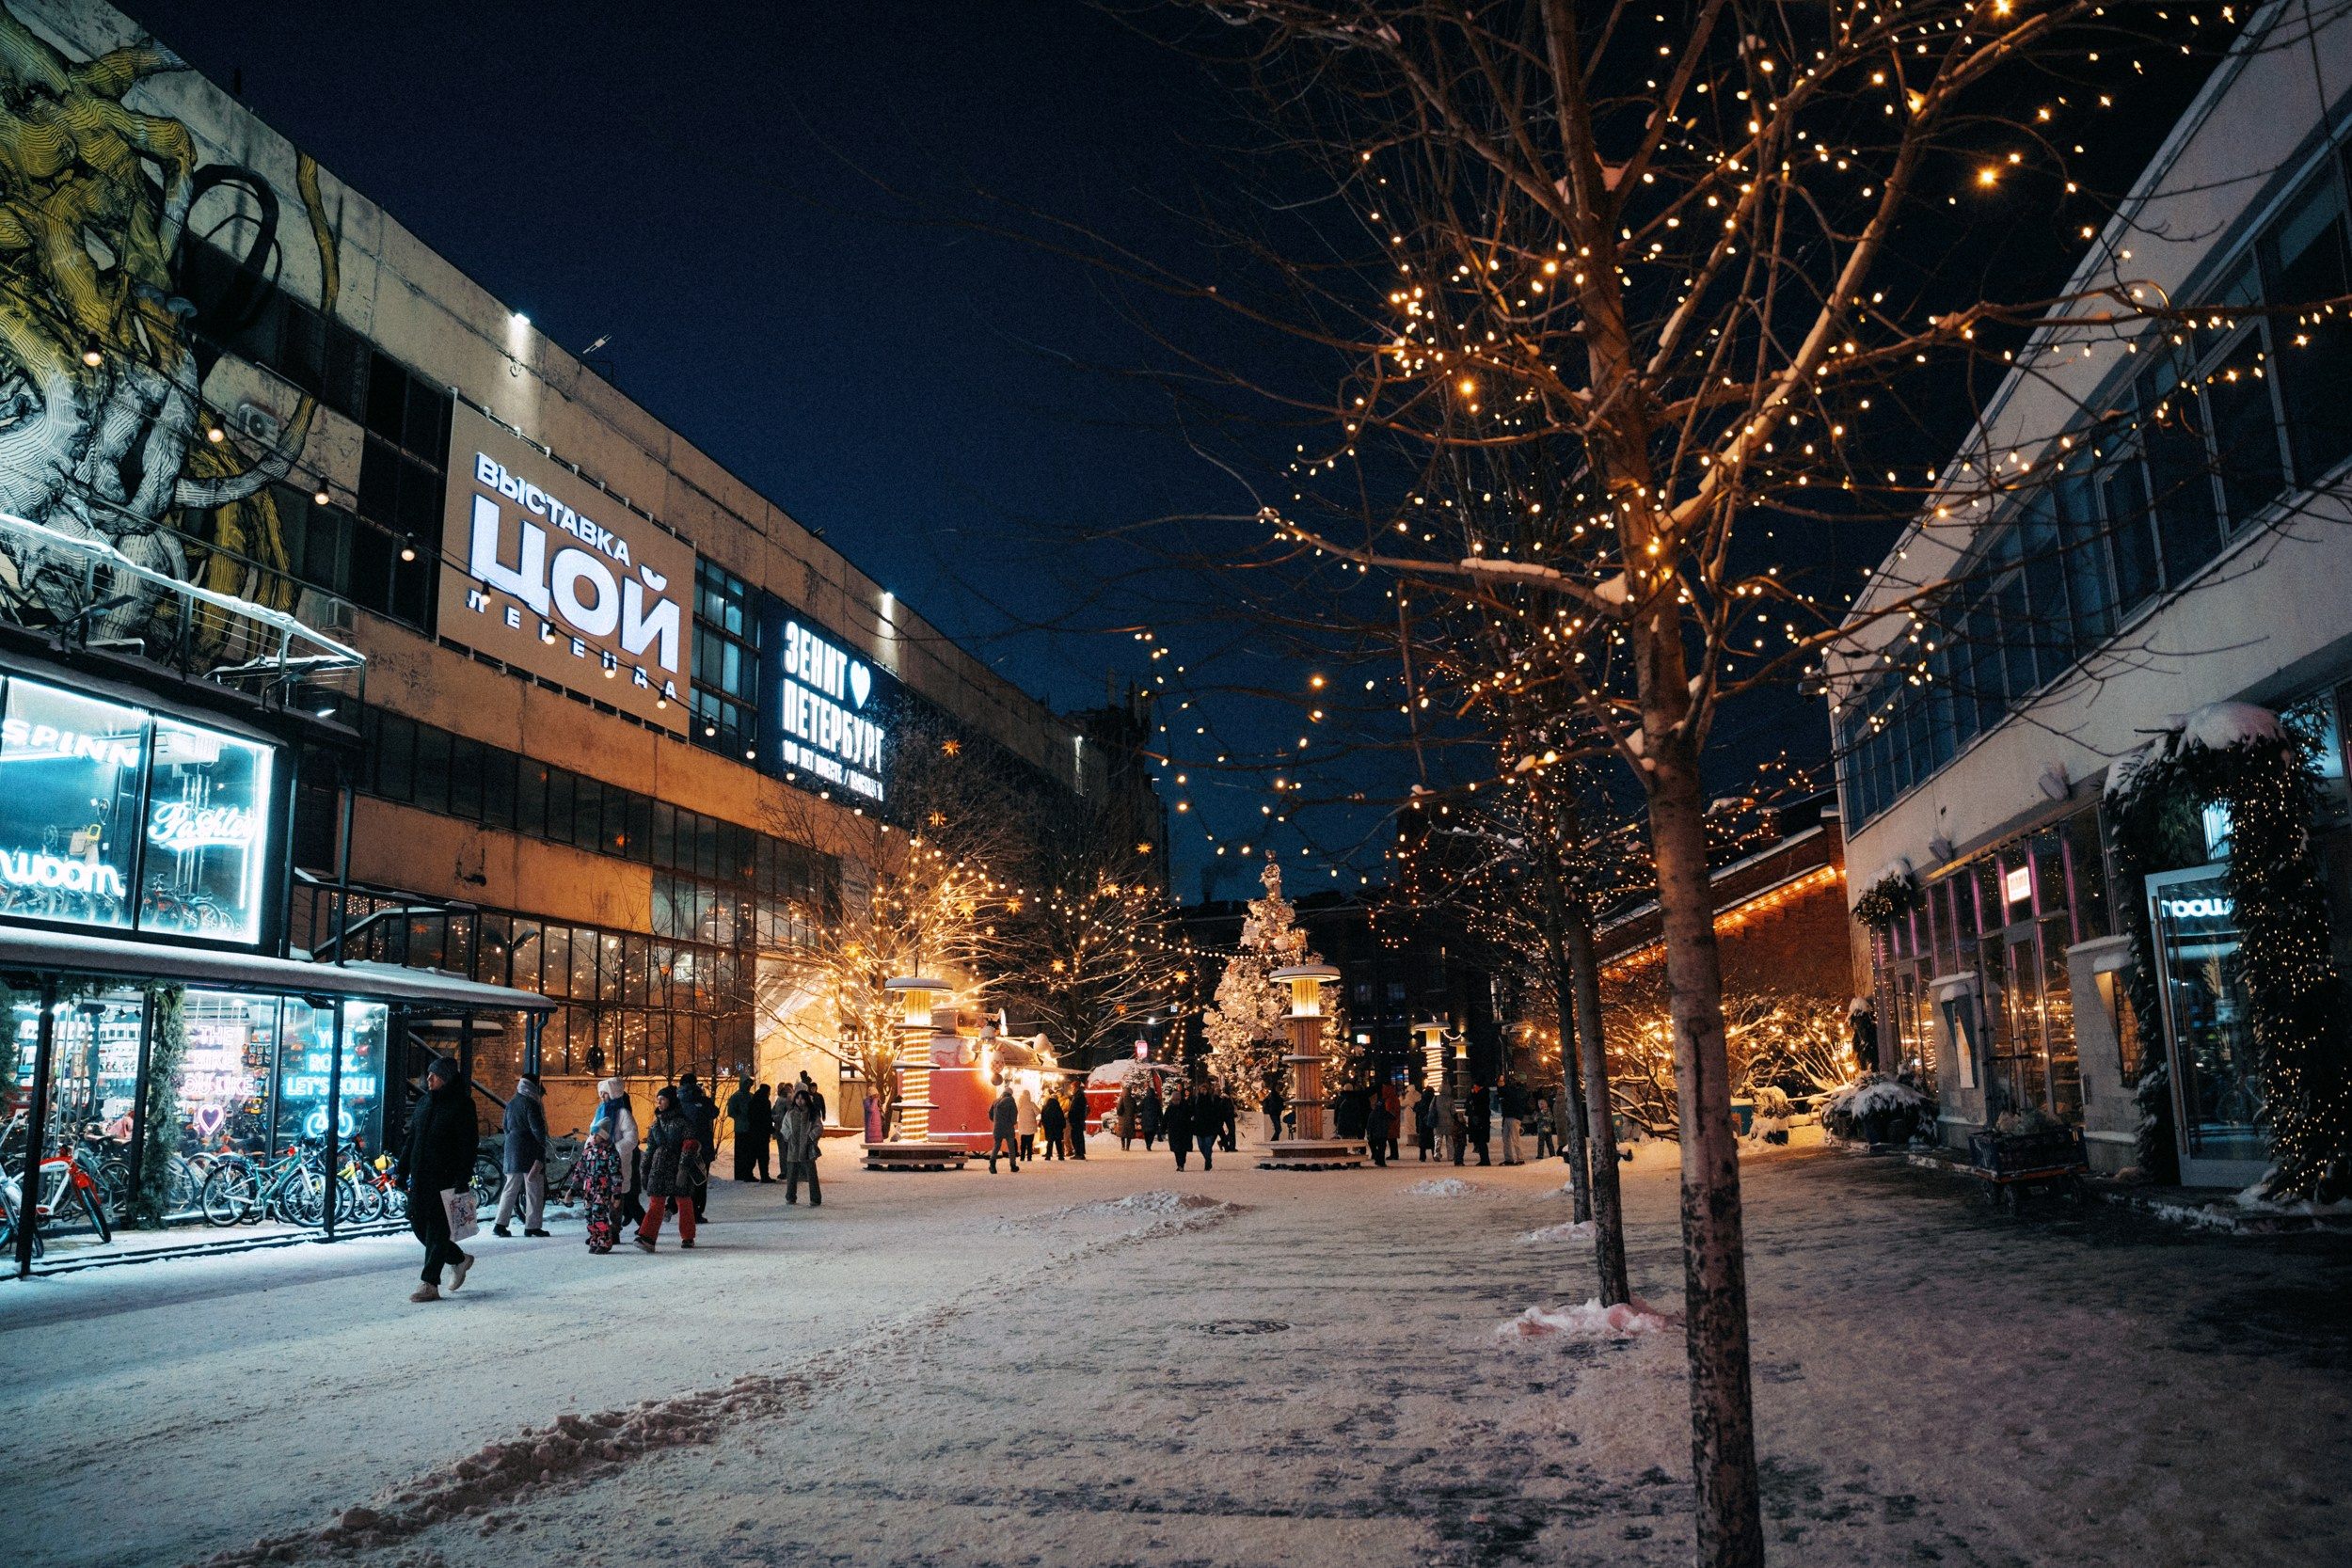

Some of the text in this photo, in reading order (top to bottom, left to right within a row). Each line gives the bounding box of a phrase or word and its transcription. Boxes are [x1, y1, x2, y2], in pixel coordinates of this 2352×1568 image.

[475, 451, 631, 568] ВЫСТАВКА
[470, 493, 680, 674] ЦОЙ
[467, 590, 678, 700] ЛЕГЕНДА
[784, 621, 848, 701] ЗЕНИТ
[782, 678, 885, 773] ПЕТЕРБУРГ
[148, 800, 259, 845] Pashley
[0, 849, 126, 897] woom
[199, 1025, 234, 1046] THE
[194, 1051, 235, 1071] BIKE
[309, 1053, 358, 1072] ROK.
[183, 1075, 254, 1096] OU LIKE
[286, 1076, 374, 1095] LET'S OLL!
